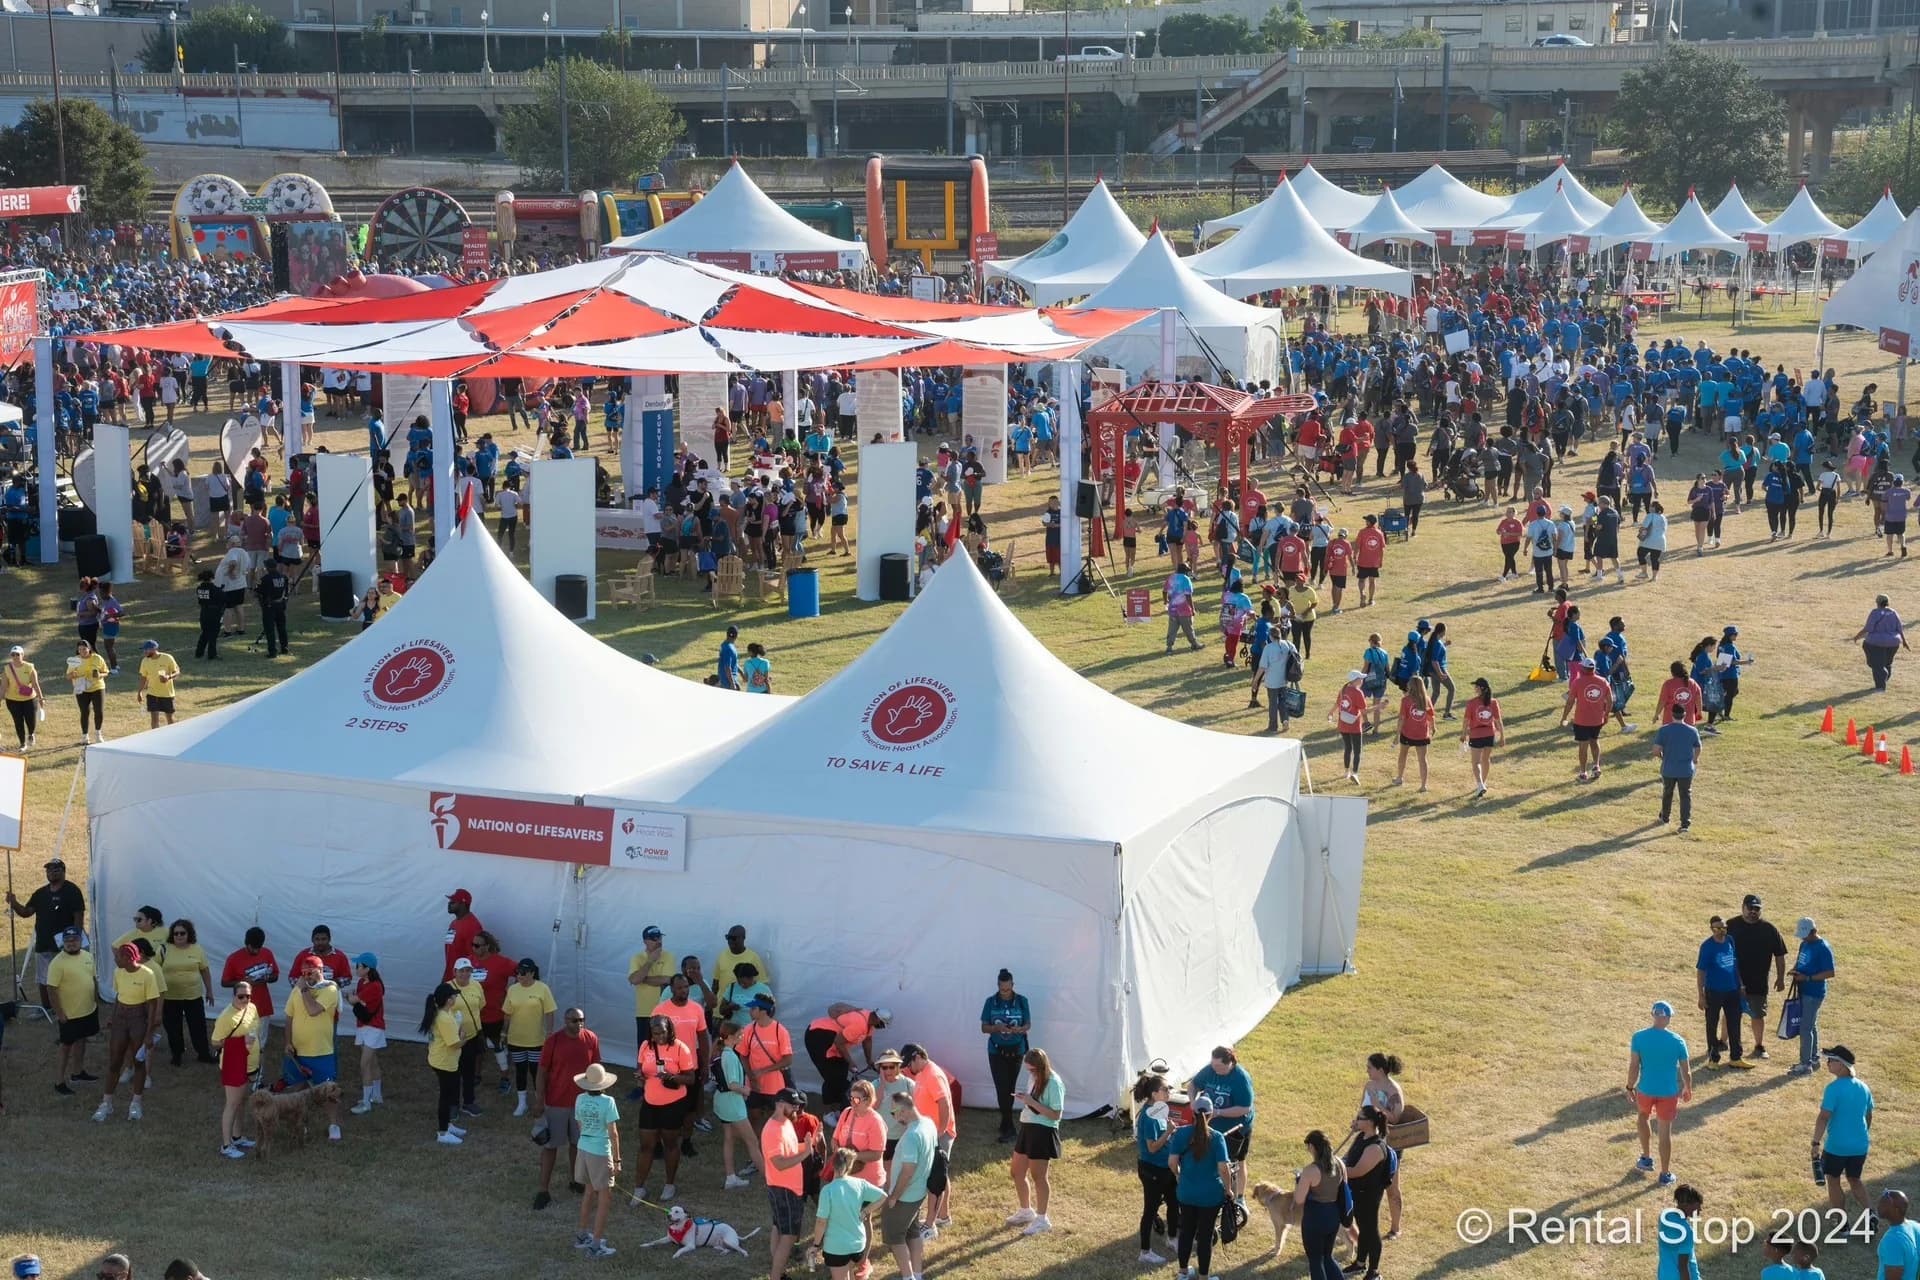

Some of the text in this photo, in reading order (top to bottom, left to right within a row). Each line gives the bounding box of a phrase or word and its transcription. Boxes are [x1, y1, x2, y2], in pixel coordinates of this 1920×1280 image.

[0, 194, 30, 210] ERE!
[364, 639, 456, 683] NATION OF LIFESAVERS
[387, 703, 416, 712] Heart
[417, 671, 456, 707] Association
[861, 676, 957, 723] NATION OF LIFESAVERS
[345, 717, 409, 733] 2 STEPS
[861, 709, 958, 752] American Heart Association
[826, 757, 946, 778] TO SAVE A LIFE
[467, 818, 604, 842] NATION OF LIFESAVERS
[643, 847, 669, 856] POWER
